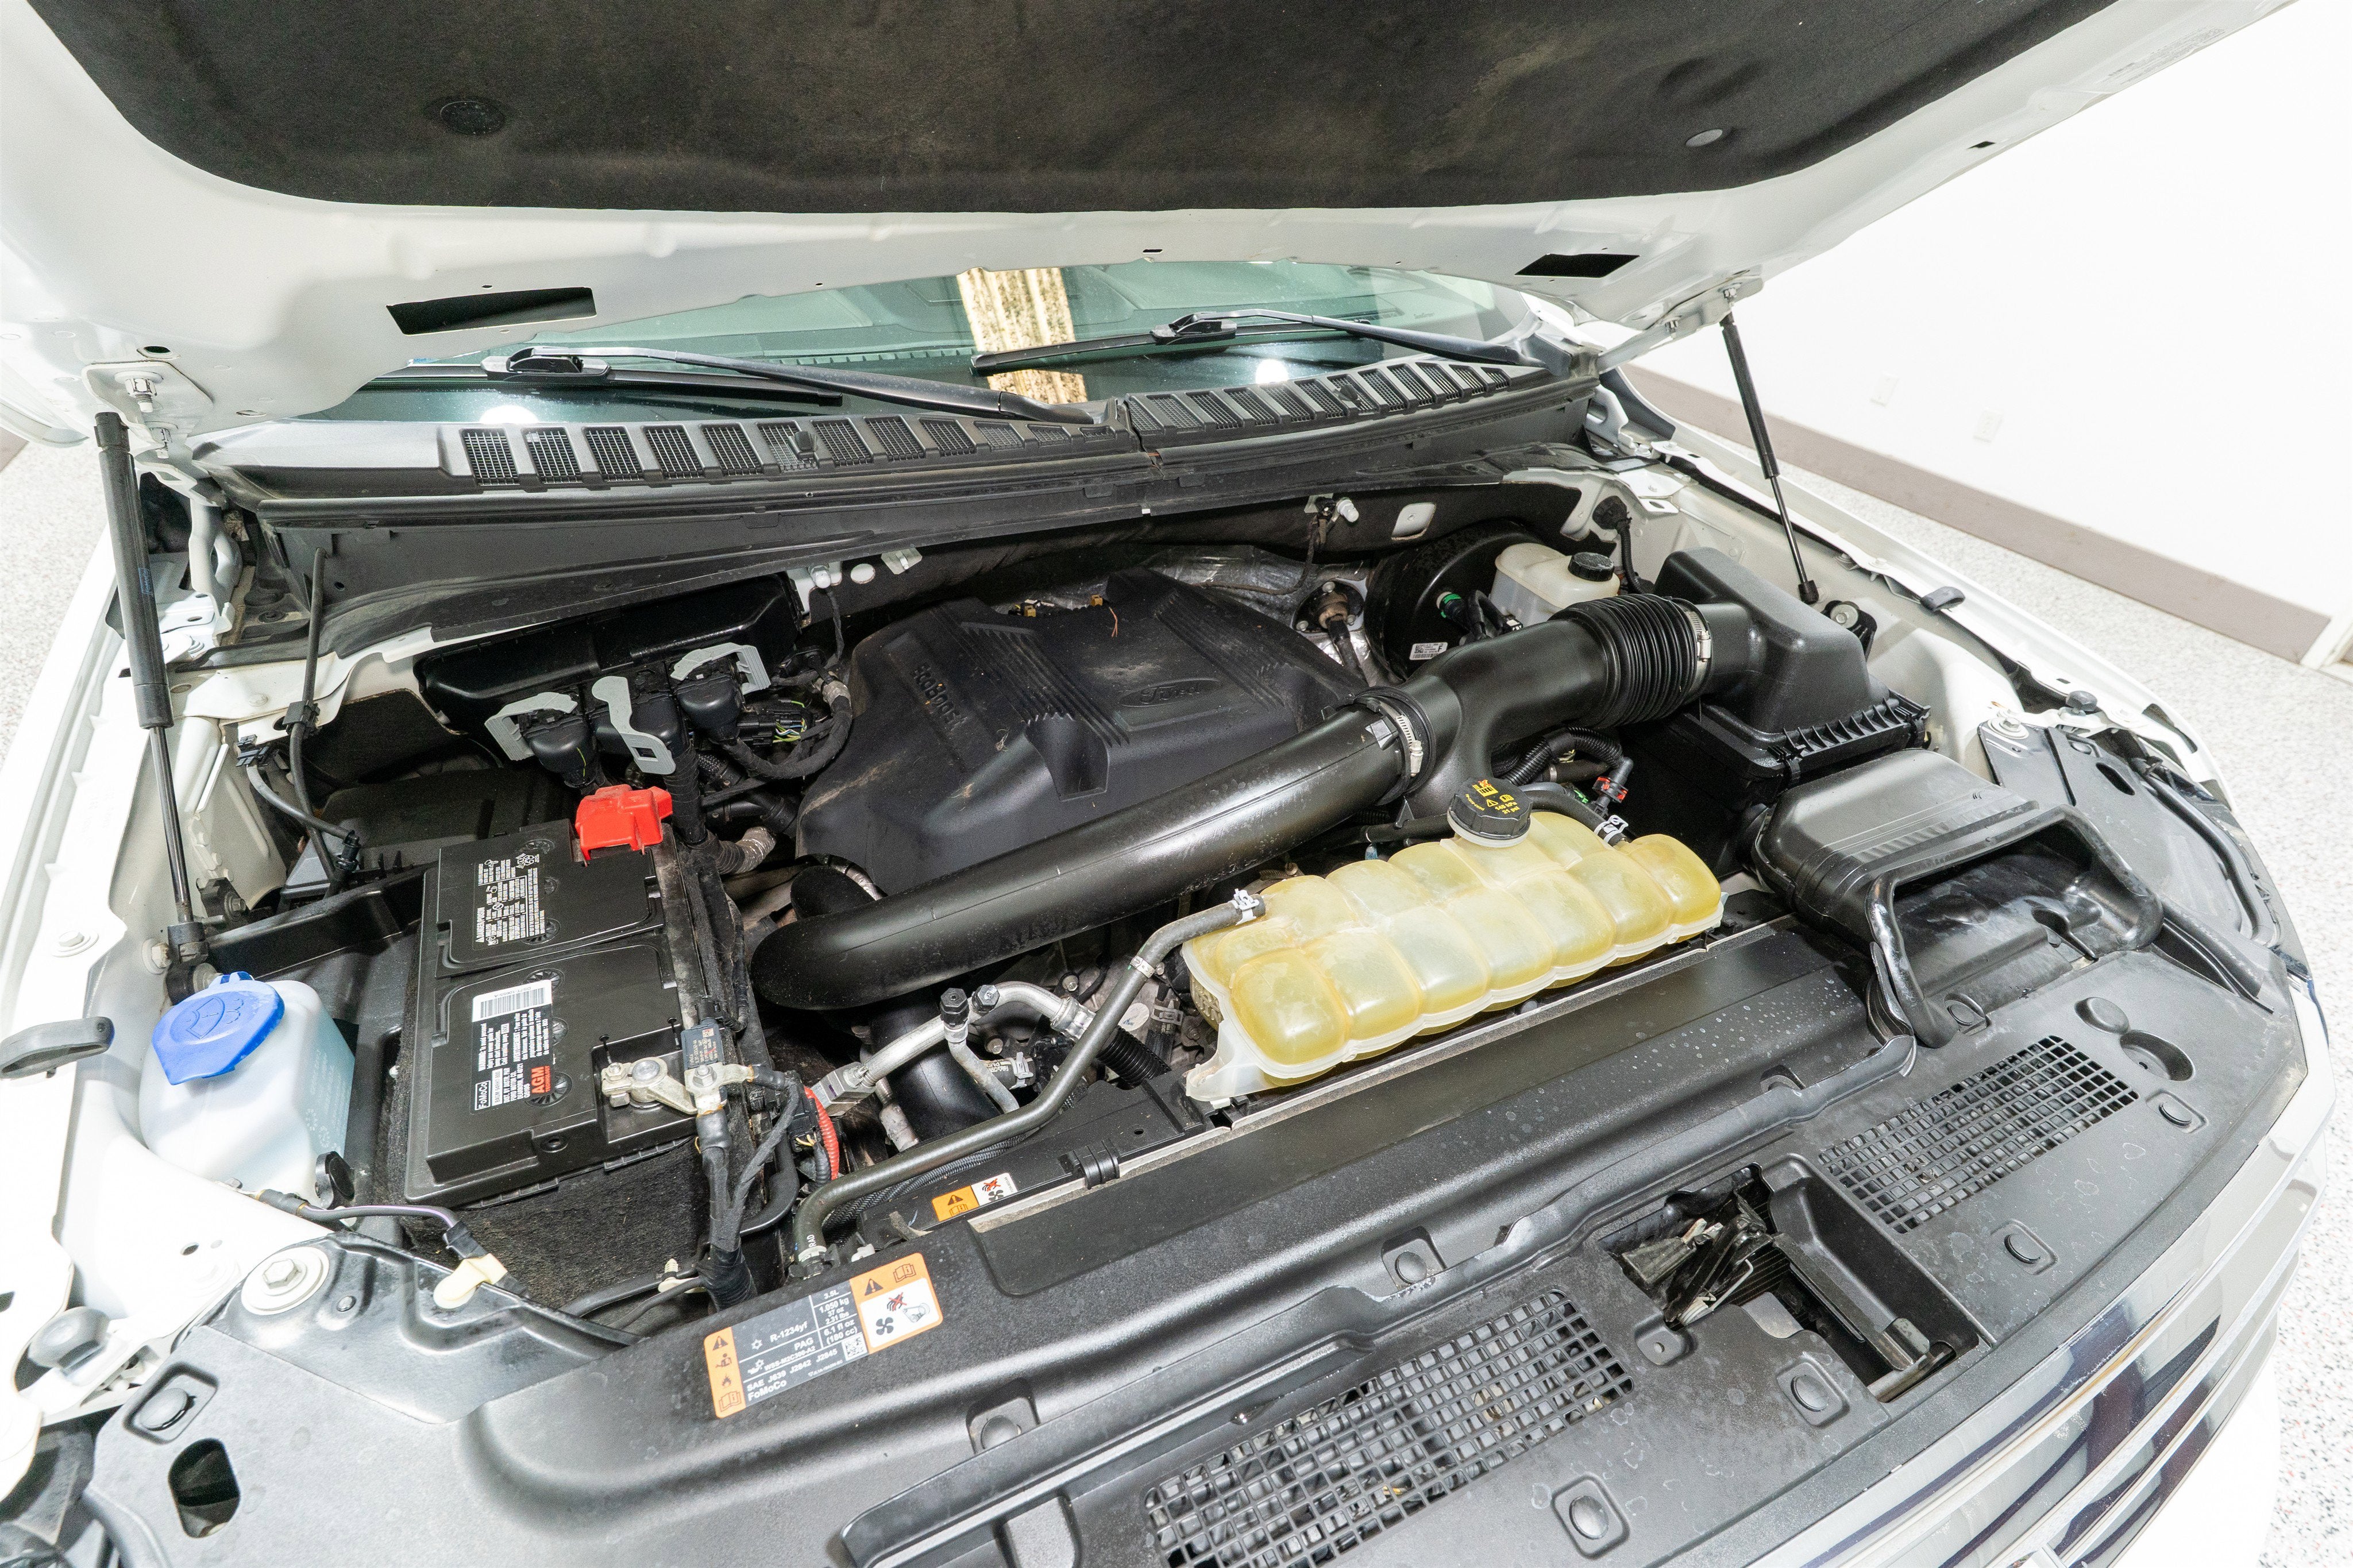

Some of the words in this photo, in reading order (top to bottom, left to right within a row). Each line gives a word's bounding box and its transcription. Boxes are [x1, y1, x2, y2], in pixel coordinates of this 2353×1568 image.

[913, 662, 968, 732] EcoBoost
[1140, 683, 1201, 705] Ford
[531, 1066, 545, 1094] AGM
[479, 1082, 488, 1109] FoMoCo
[807, 1234, 817, 1248] RAD
[824, 1289, 839, 1299] 3.5L
[819, 1301, 839, 1314] 1.050
[839, 1297, 850, 1306] kg
[828, 1309, 835, 1317] 37
[826, 1315, 838, 1324] 2.31
[838, 1311, 850, 1319] lbs
[770, 1321, 808, 1343] R-1234yf
[824, 1326, 836, 1336] 6.1
[845, 1319, 855, 1327] oz
[826, 1331, 844, 1345] (180
[845, 1326, 858, 1336] cc)
[794, 1337, 814, 1351] PAG
[747, 1380, 765, 1392] SAE
[747, 1380, 787, 1401] FoMoCo
